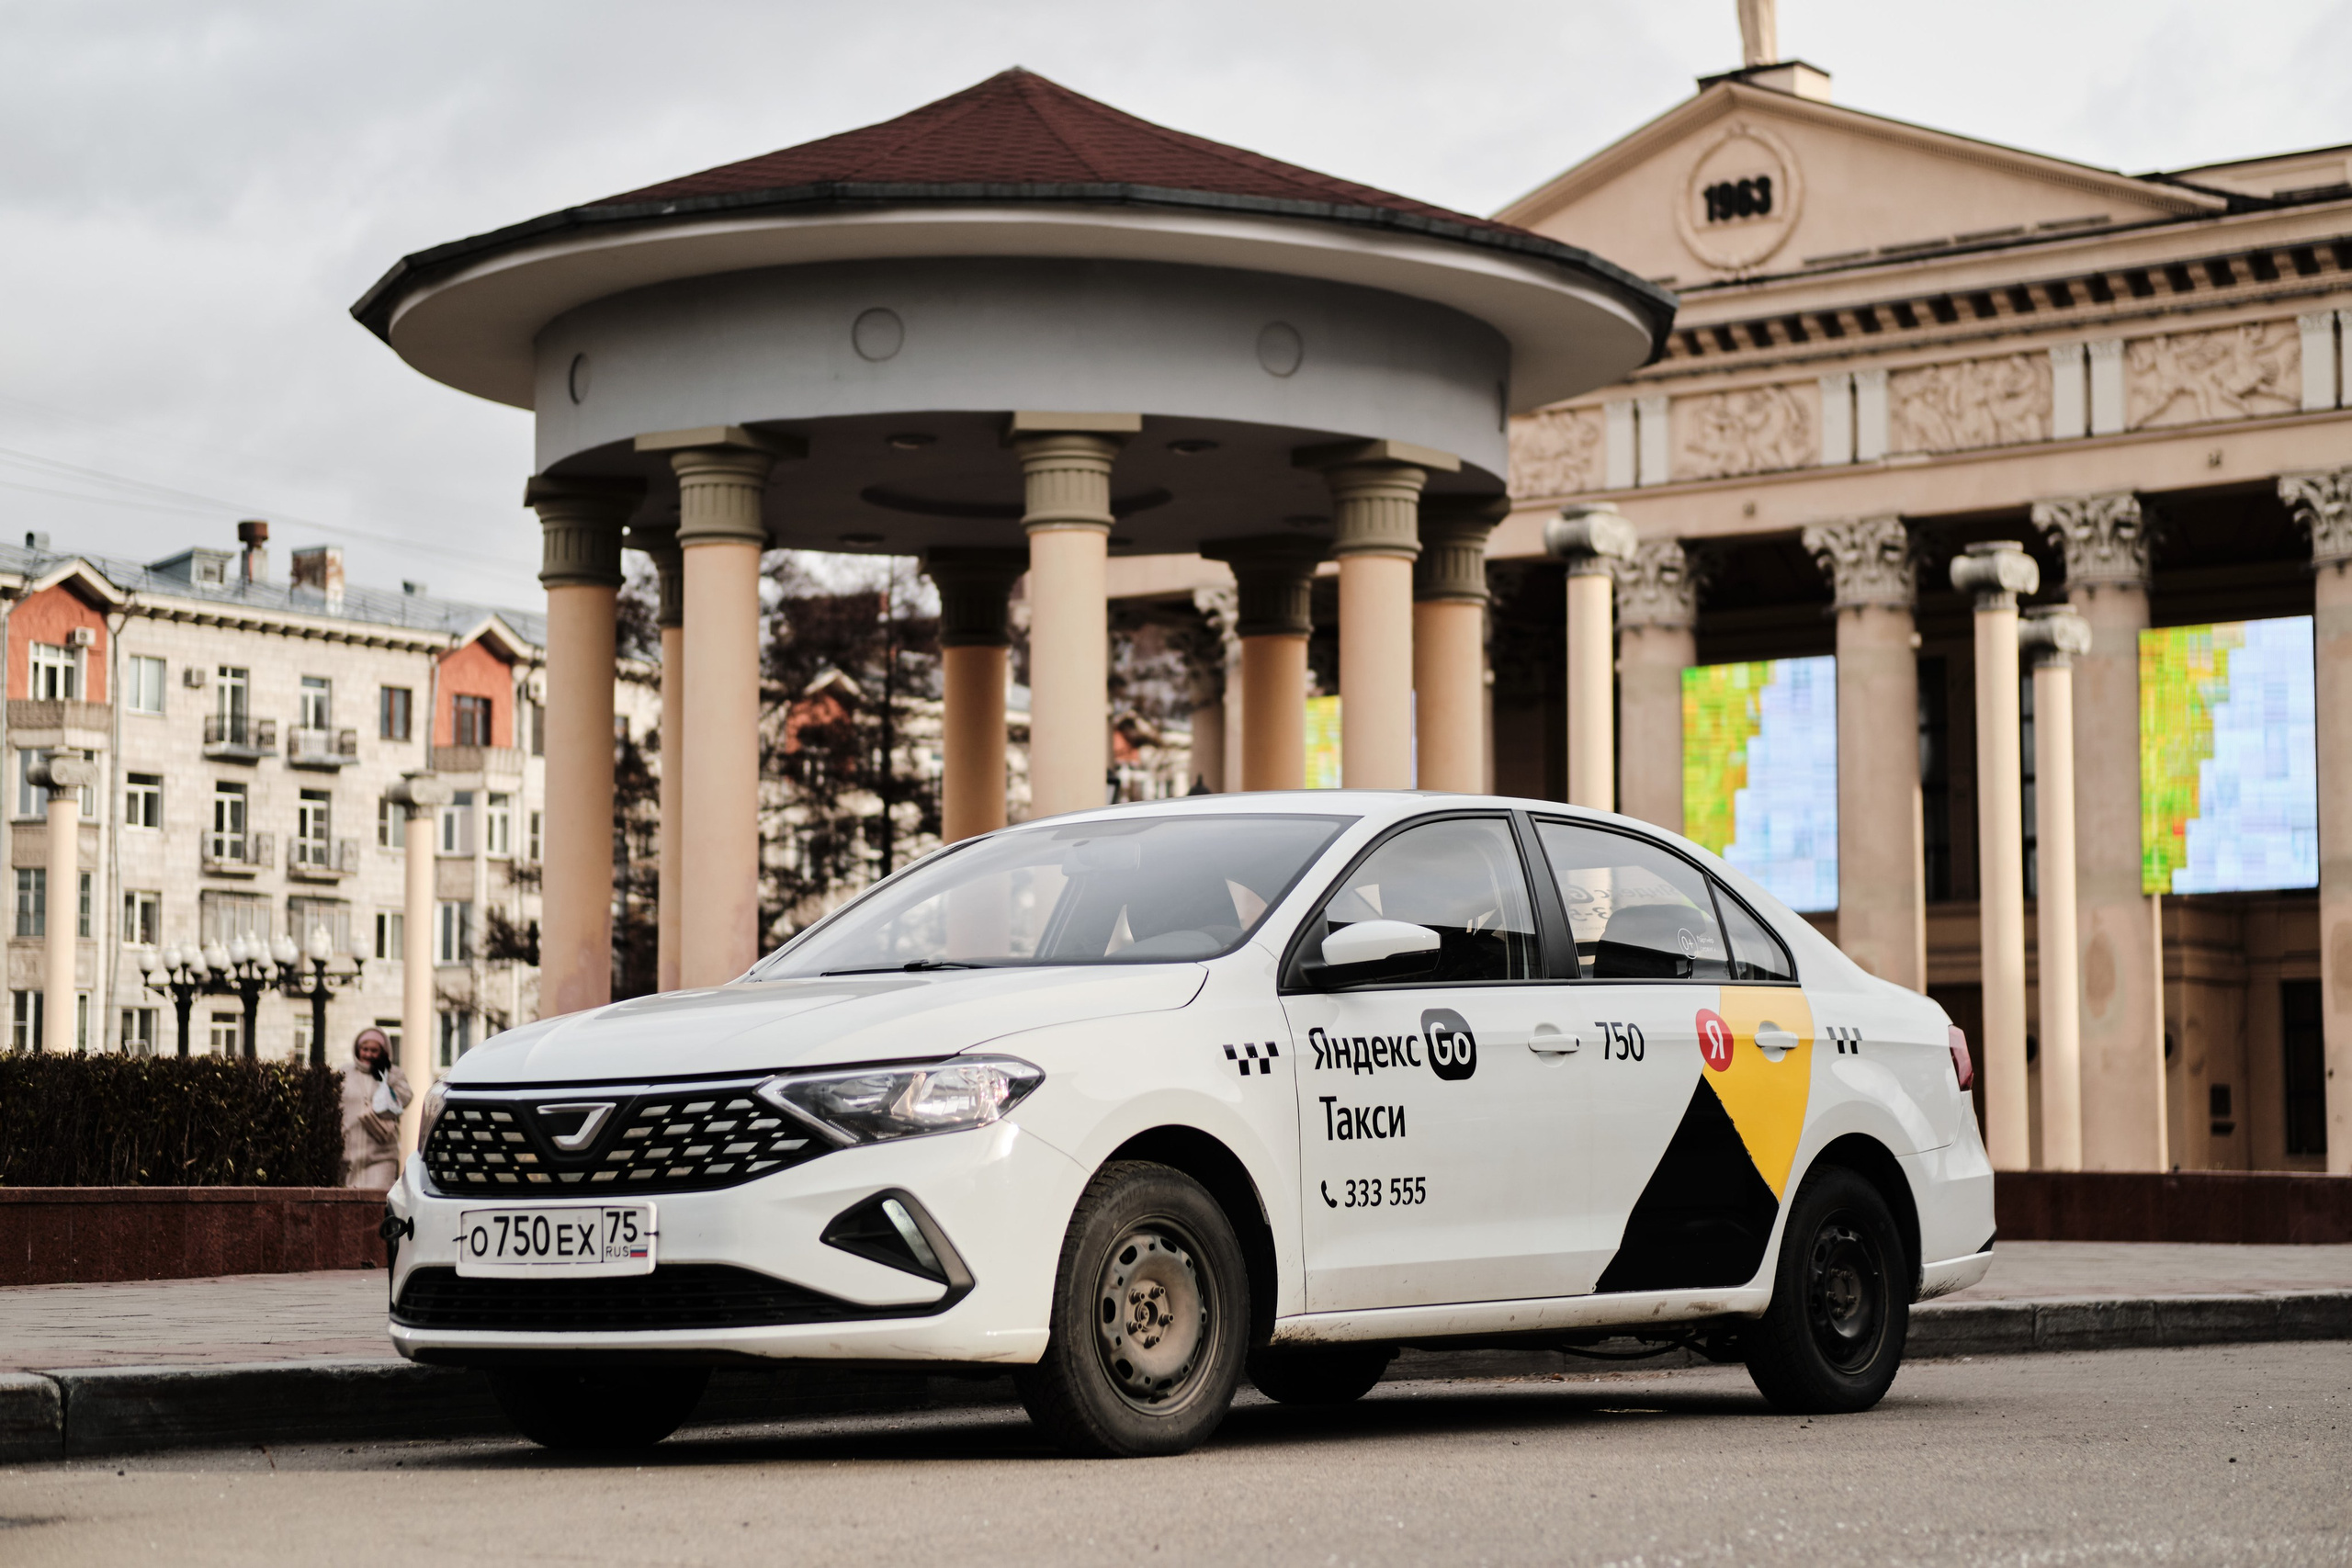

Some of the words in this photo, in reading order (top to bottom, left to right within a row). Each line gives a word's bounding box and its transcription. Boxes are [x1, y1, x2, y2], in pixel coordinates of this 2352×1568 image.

[1702, 175, 1772, 223] 1963
[1308, 1027, 1421, 1075] Яндекс
[1430, 1021, 1470, 1066] Go
[1594, 1021, 1645, 1062] 750
[1706, 1020, 1725, 1059] Я
[1319, 1096, 1406, 1141] Такси
[1344, 1179, 1383, 1208] 333
[1389, 1177, 1427, 1205] 555
[605, 1211, 639, 1243] 75
[605, 1247, 629, 1258] RUS
